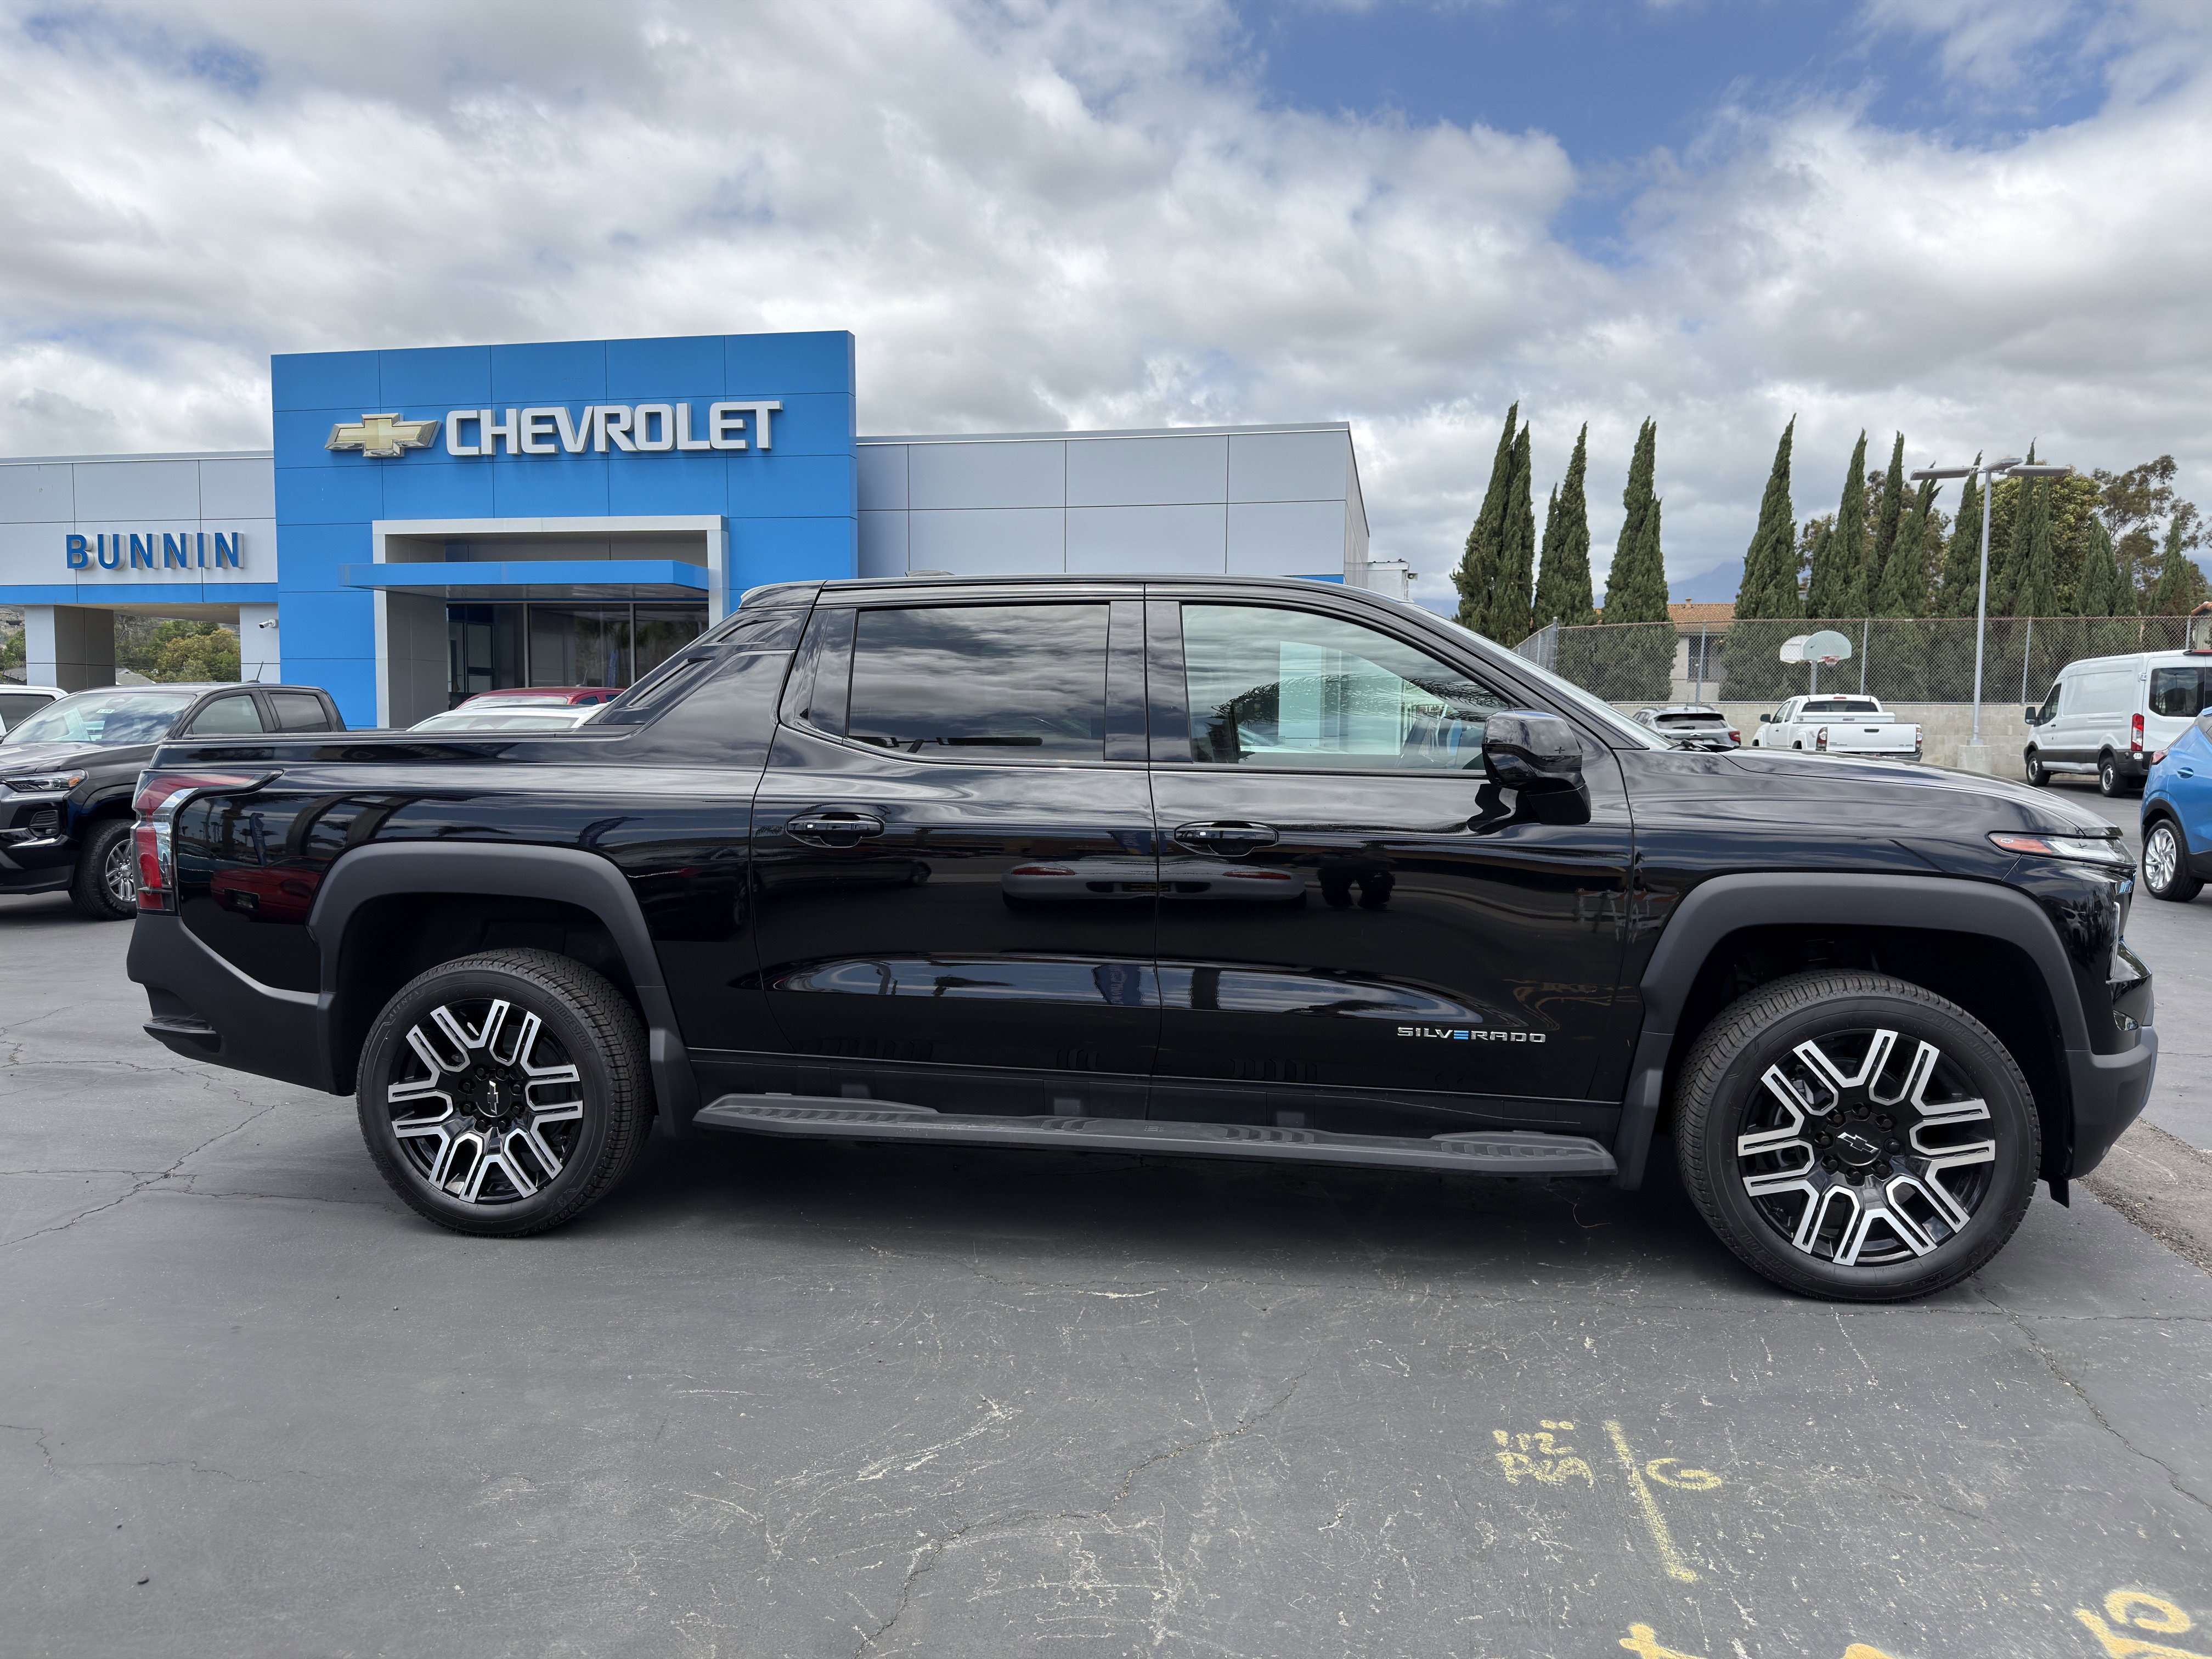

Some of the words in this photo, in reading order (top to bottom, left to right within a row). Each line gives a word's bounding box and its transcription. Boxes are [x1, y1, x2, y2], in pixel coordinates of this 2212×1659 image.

[447, 400, 783, 456] CHEVROLET
[66, 532, 244, 569] BUNNIN
[388, 987, 424, 1019] ALENZA
[544, 996, 594, 1054] BRIDGESTONE
[1397, 1026, 1546, 1043] SILVERADO
